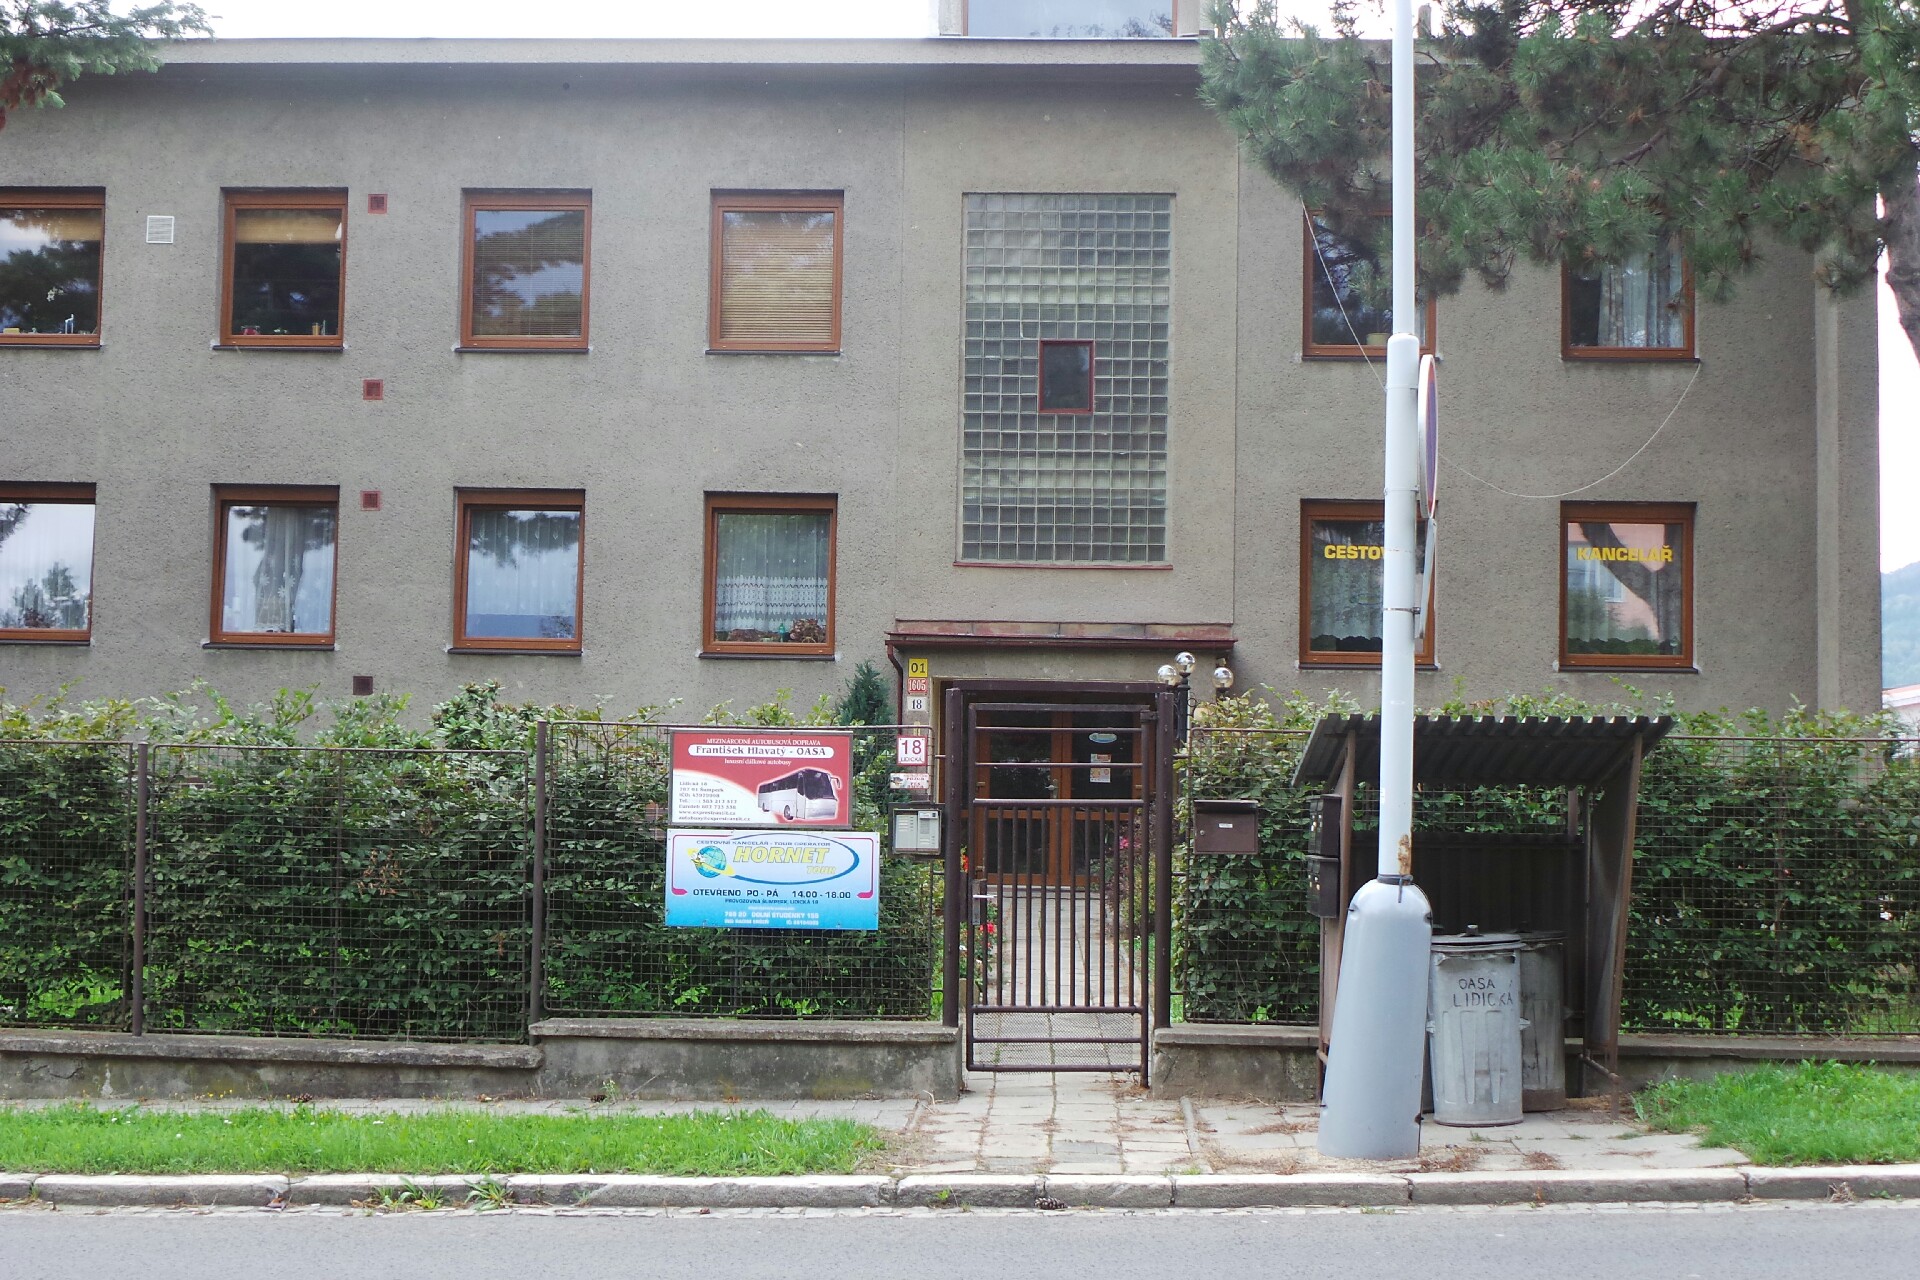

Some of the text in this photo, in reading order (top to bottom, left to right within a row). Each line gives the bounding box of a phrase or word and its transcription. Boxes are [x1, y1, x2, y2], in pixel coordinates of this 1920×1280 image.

[911, 663, 926, 674] 01
[908, 678, 926, 691] 1605
[912, 698, 922, 710] 18
[706, 737, 751, 745] MEZINÁRODNÍ
[752, 738, 792, 746] AUTOBUSOVÁ
[901, 739, 922, 755] 18
[696, 745, 744, 754] František
[747, 746, 786, 757] Hlavatý
[796, 747, 826, 756] OASA
[767, 759, 792, 767] autobusy
[733, 845, 830, 864] HORNET
[806, 866, 836, 874] TOUR
[693, 888, 742, 897] OTEVŘENO
[746, 889, 759, 897] PO
[766, 889, 779, 898] PÁ
[792, 890, 818, 898] 14.00
[825, 891, 851, 899] 18.00
[1458, 977, 1496, 990] OASA
